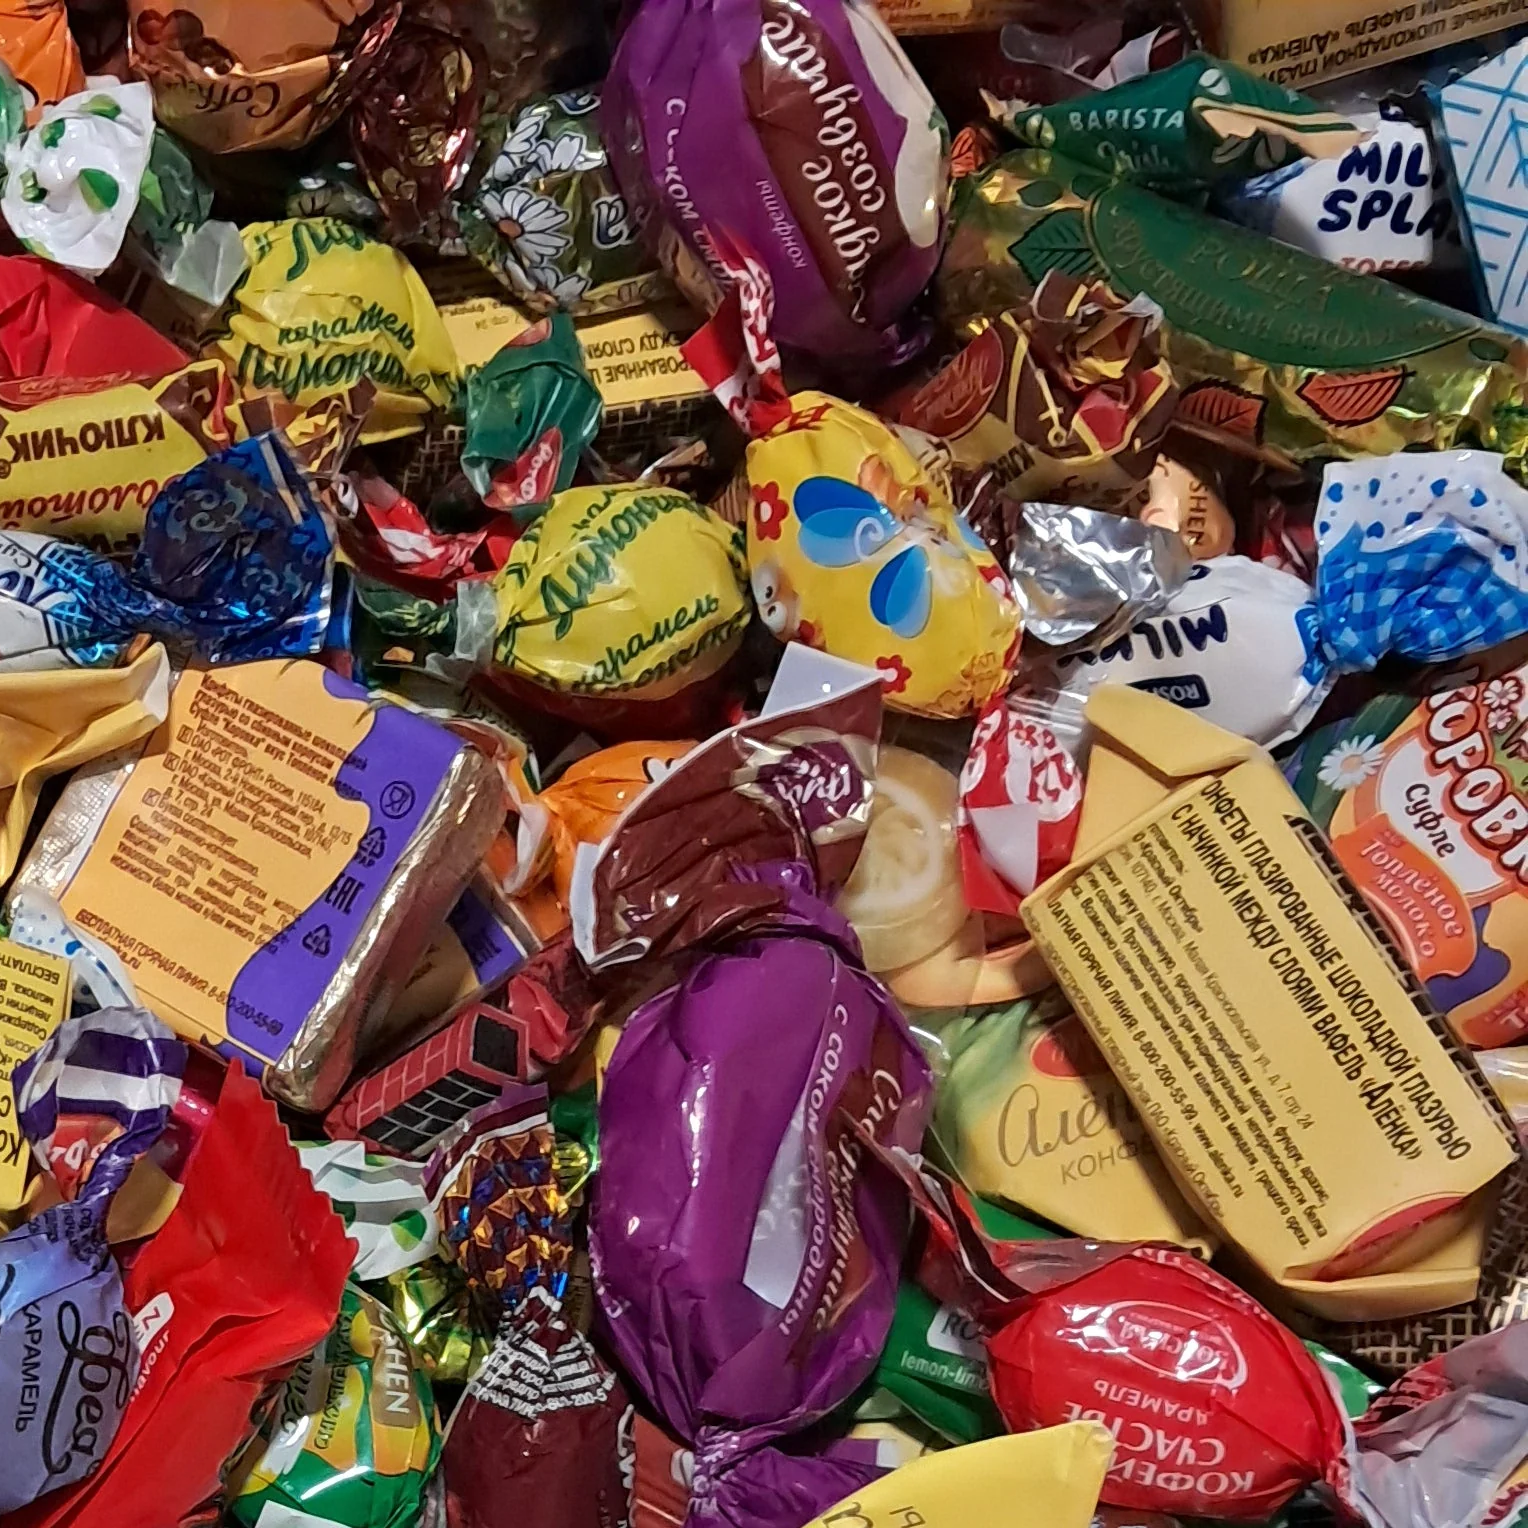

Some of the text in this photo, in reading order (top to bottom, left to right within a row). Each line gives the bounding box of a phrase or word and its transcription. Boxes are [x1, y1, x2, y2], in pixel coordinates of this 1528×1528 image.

[761, 13, 885, 217] созвучие
[1068, 107, 1185, 132] BARISTA
[1337, 142, 1429, 185] MIL
[755, 177, 807, 270] конфеты
[4, 410, 166, 465] КЛЮЧИК
[1403, 782, 1457, 859] Суфле
[1168, 802, 1435, 1166] С НАЧИНКОЙ МЕЖДУ СЛОЯМИ ВАФЕЛЬ «АЛЁНКА»
[1196, 776, 1475, 1165] ОНФЕТЫ ГЛАЗИРОВАННЫЕ ШОКОЛАДНОЙ ГЛАЗУРЬЮ
[16, 1302, 47, 1434] КАРАМЕЛЬ
[1104, 1446, 1256, 1498] КОФЕЙ
